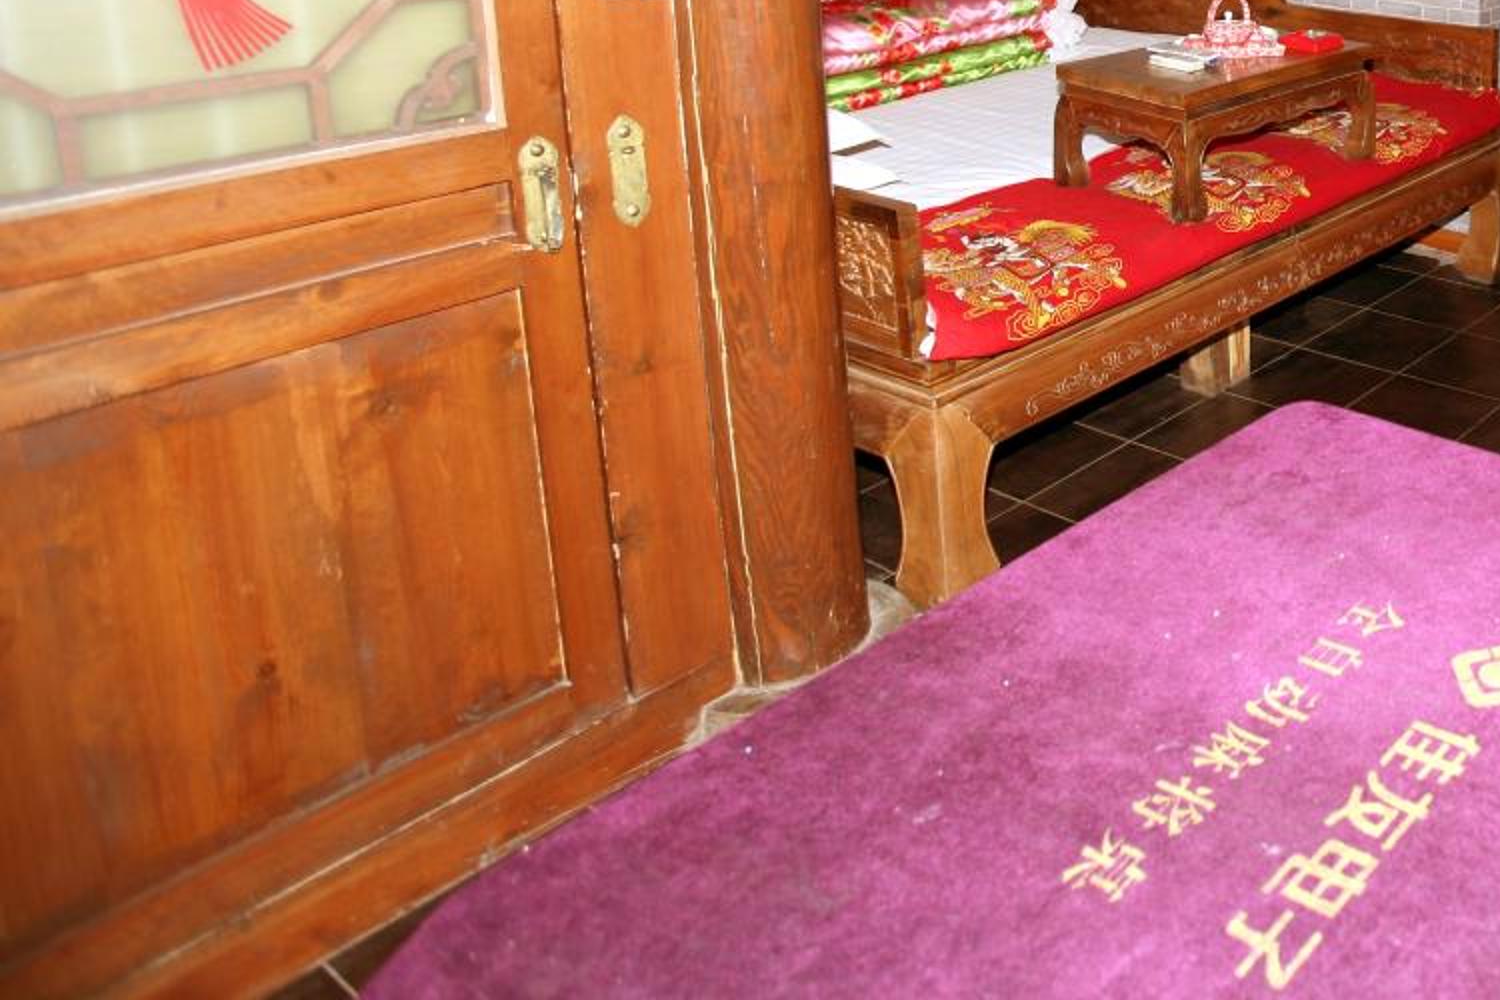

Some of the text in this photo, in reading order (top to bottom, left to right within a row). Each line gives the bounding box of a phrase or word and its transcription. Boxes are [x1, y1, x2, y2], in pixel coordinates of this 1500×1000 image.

[1062, 600, 1404, 902] 全自动麻将桌
[1226, 722, 1481, 989] 佳友电子
